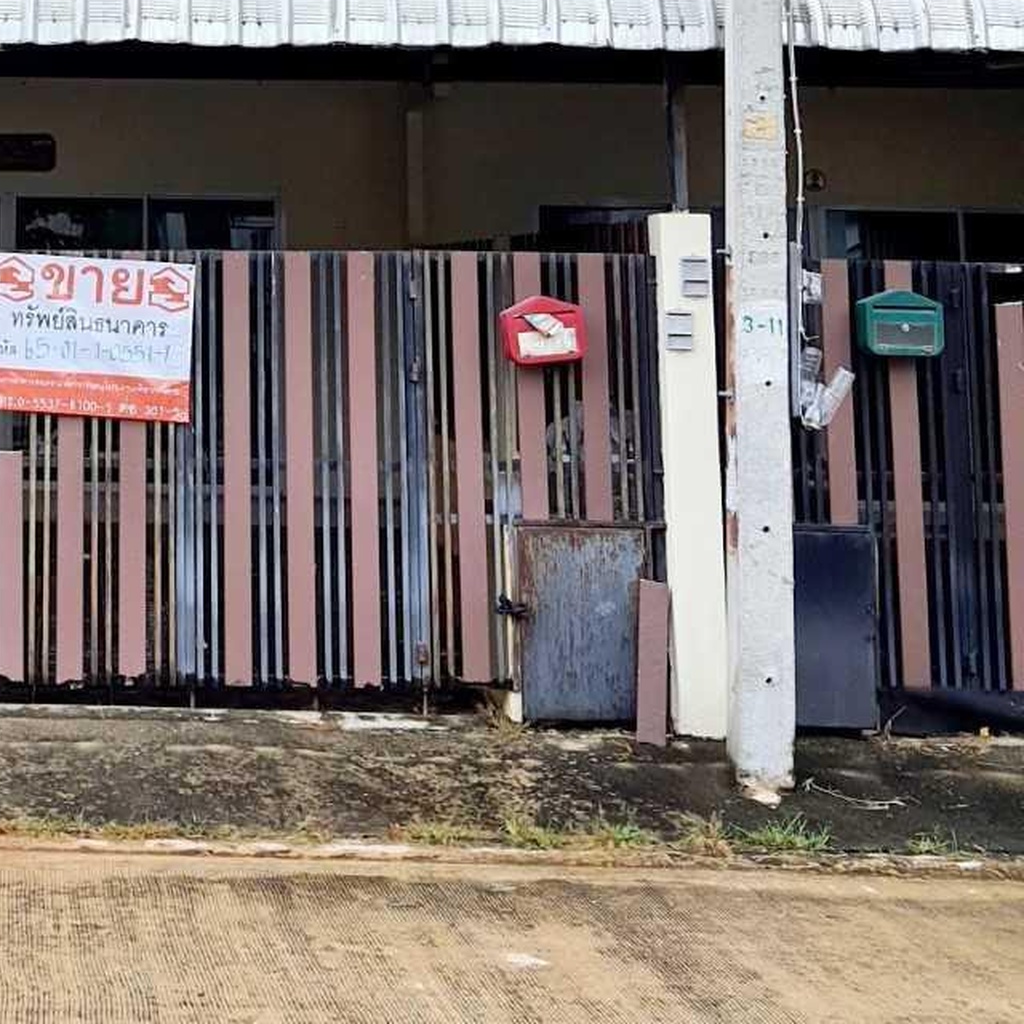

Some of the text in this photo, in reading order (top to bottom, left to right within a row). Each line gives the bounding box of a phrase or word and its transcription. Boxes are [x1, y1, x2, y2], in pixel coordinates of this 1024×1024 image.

[40, 262, 145, 306] ขาย
[12, 305, 168, 337] ทรัพย์สินธนาคาร
[742, 315, 784, 335] 3-11
